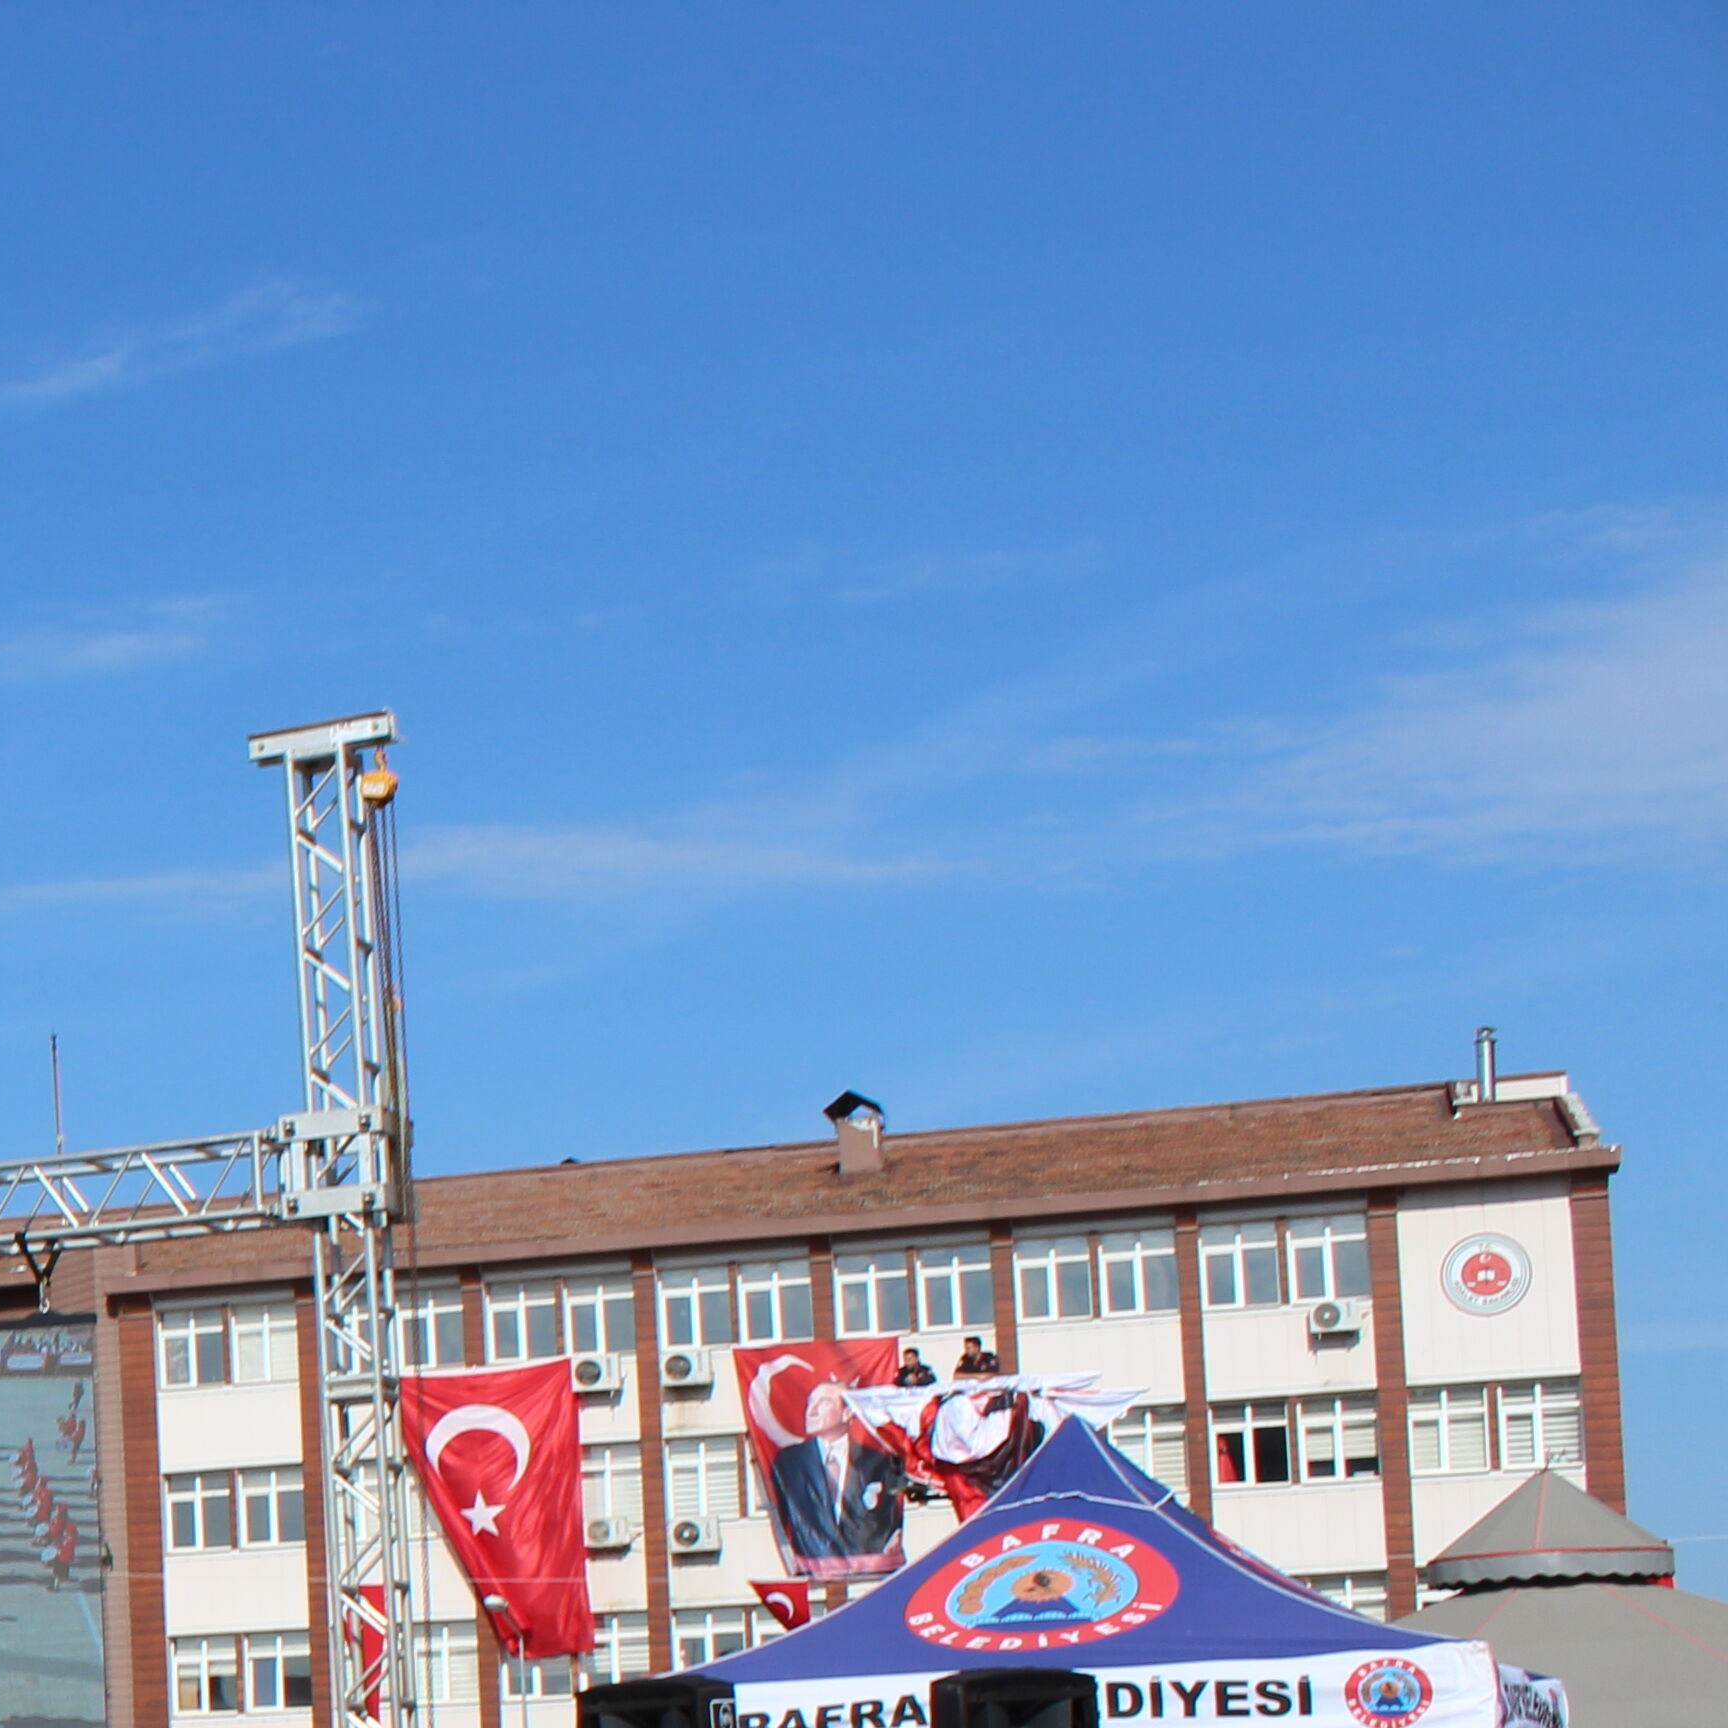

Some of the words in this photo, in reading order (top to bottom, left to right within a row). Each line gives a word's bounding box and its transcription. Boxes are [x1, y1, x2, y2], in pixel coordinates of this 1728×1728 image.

[960, 1523, 1135, 1568] BAFRA
[908, 1602, 1163, 1650] BELEDİYESİ
[1356, 1659, 1417, 1678] BAFRA
[1105, 1675, 1313, 1719] DİYESİ
